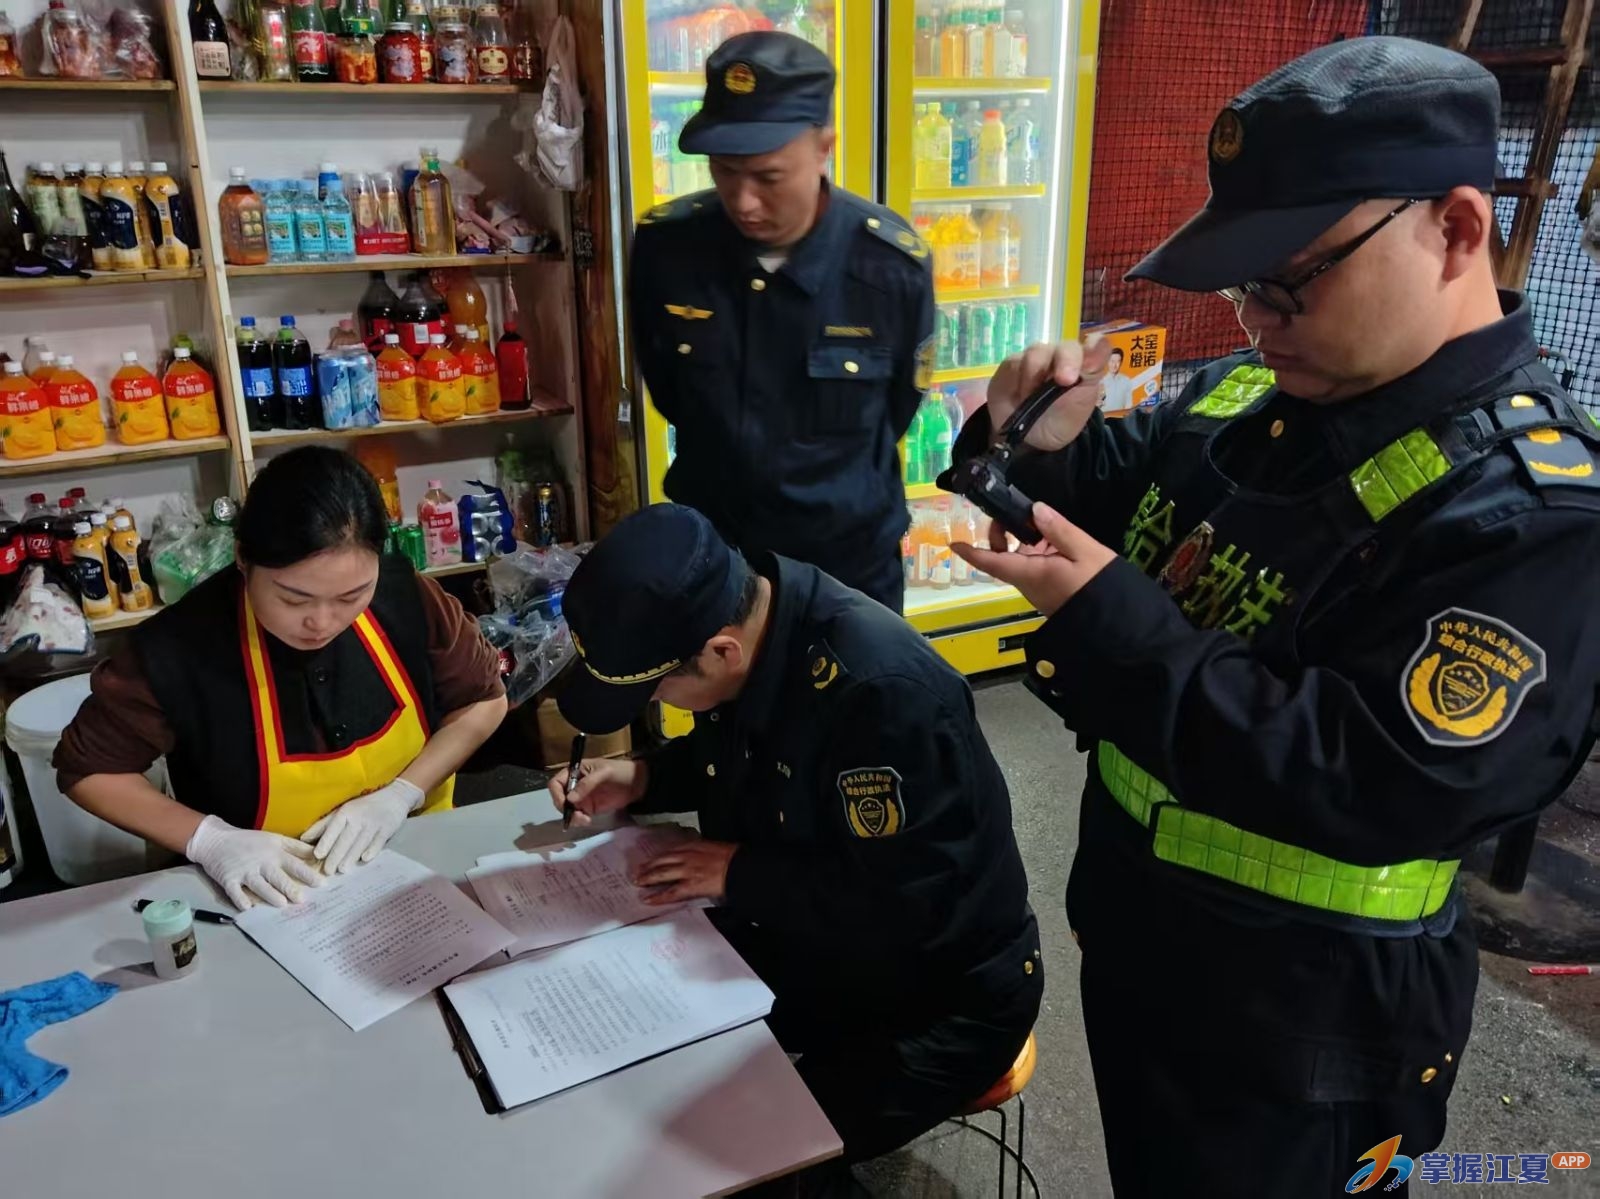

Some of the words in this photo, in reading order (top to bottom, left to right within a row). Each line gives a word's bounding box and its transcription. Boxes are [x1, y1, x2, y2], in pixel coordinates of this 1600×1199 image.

[1438, 633, 1523, 682] 综合行政执法
[1440, 621, 1534, 671] 中华人民共和国
[842, 772, 892, 788] 中华人民共和国
